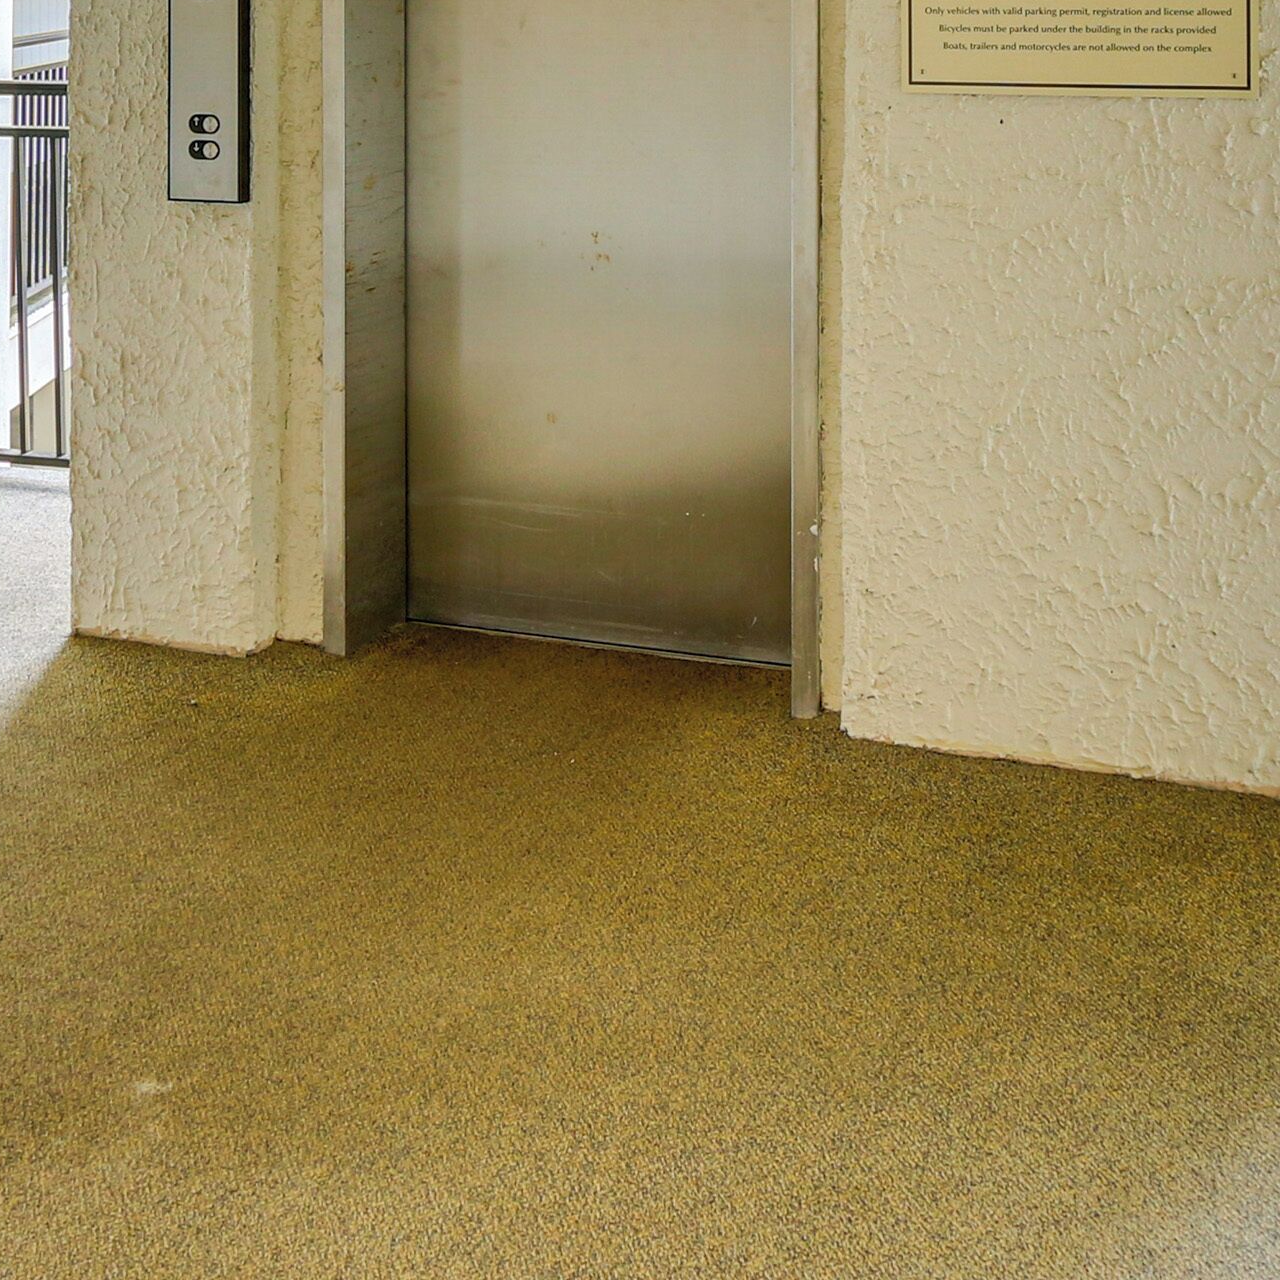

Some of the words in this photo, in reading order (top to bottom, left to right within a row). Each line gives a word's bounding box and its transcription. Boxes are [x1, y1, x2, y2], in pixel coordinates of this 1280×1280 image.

[924, 7, 944, 16] Only
[946, 7, 980, 15] vehicles
[981, 7, 1001, 15] with
[1003, 7, 1023, 15] valid
[1025, 7, 1057, 17] parking
[1059, 8, 1090, 17] permit,
[1092, 8, 1142, 17] registration
[1197, 8, 1232, 16] allowed
[939, 24, 971, 33] Bicycles
[1009, 25, 1039, 34] parked
[1041, 25, 1067, 33] under
[1069, 25, 1084, 33] the
[1085, 25, 1121, 36] building
[1151, 25, 1174, 33] racks
[1176, 26, 1216, 36] provided
[943, 42, 967, 50] Boats,
[970, 42, 998, 50] trailers
[1018, 43, 1071, 52] motorcycles
[1106, 43, 1140, 51] allowed
[1157, 44, 1172, 52] the
[1174, 44, 1212, 54] complex
